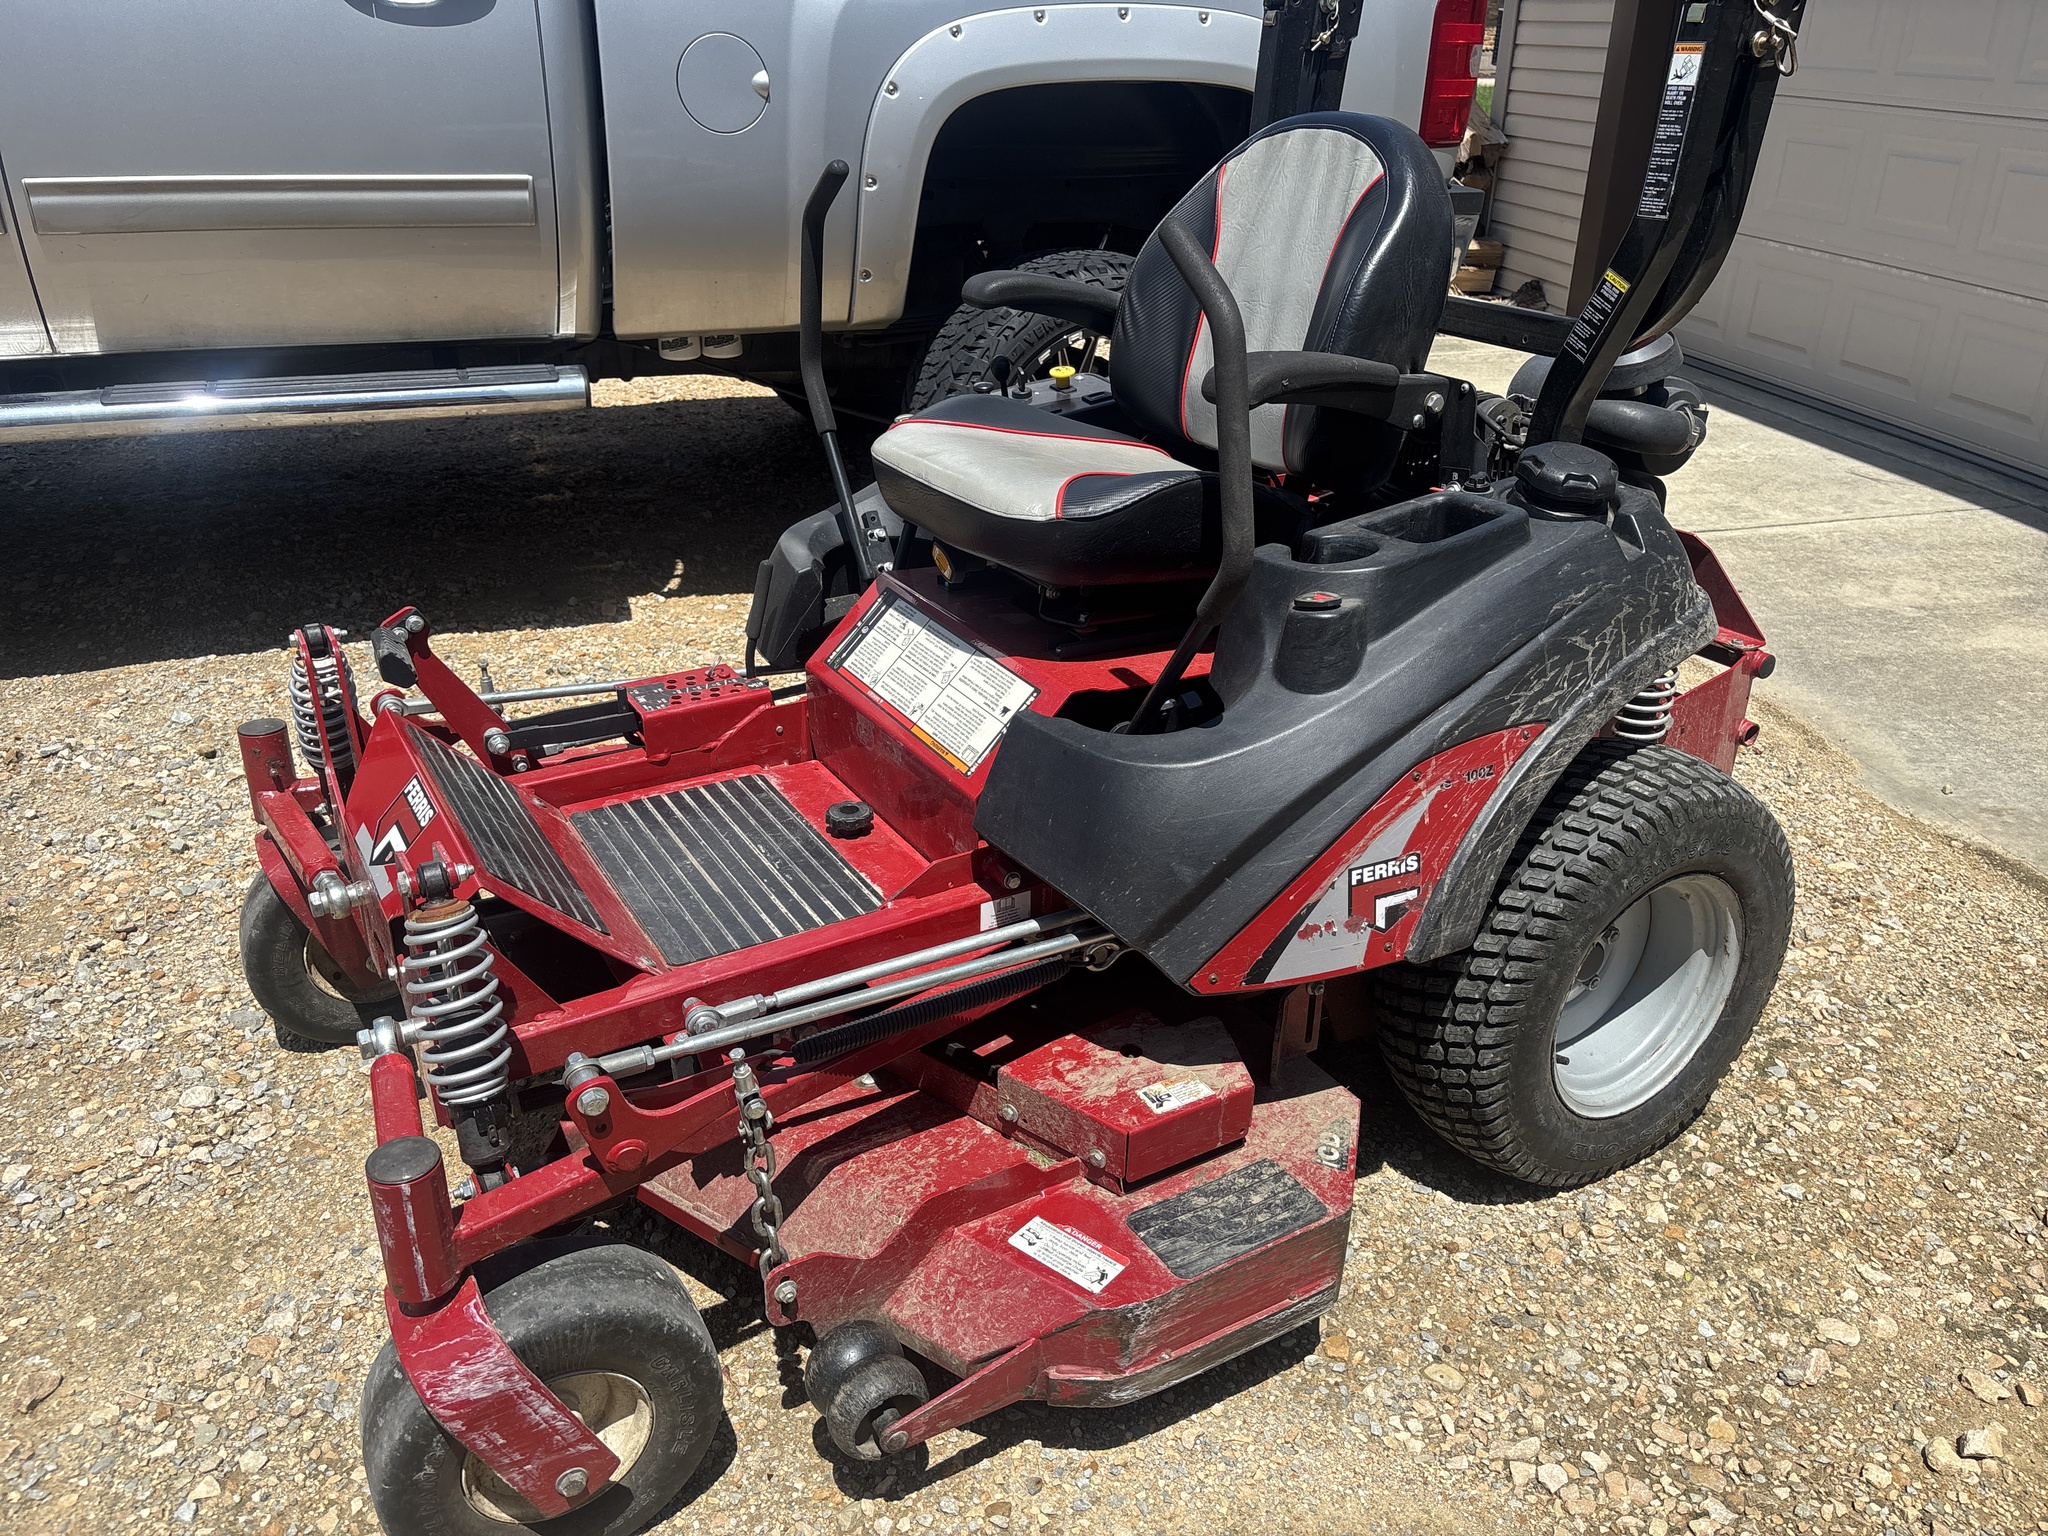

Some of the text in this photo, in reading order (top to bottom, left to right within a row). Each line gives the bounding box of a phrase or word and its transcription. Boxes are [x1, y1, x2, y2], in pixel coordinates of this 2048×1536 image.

[1609, 275, 1626, 290] CAUTION
[930, 741, 946, 754] WARNING
[404, 778, 434, 827] FERRIS
[1351, 854, 1419, 886] FERRIS
[1071, 1230, 1102, 1250] DANGER
[651, 1354, 698, 1457] CARLISLE
